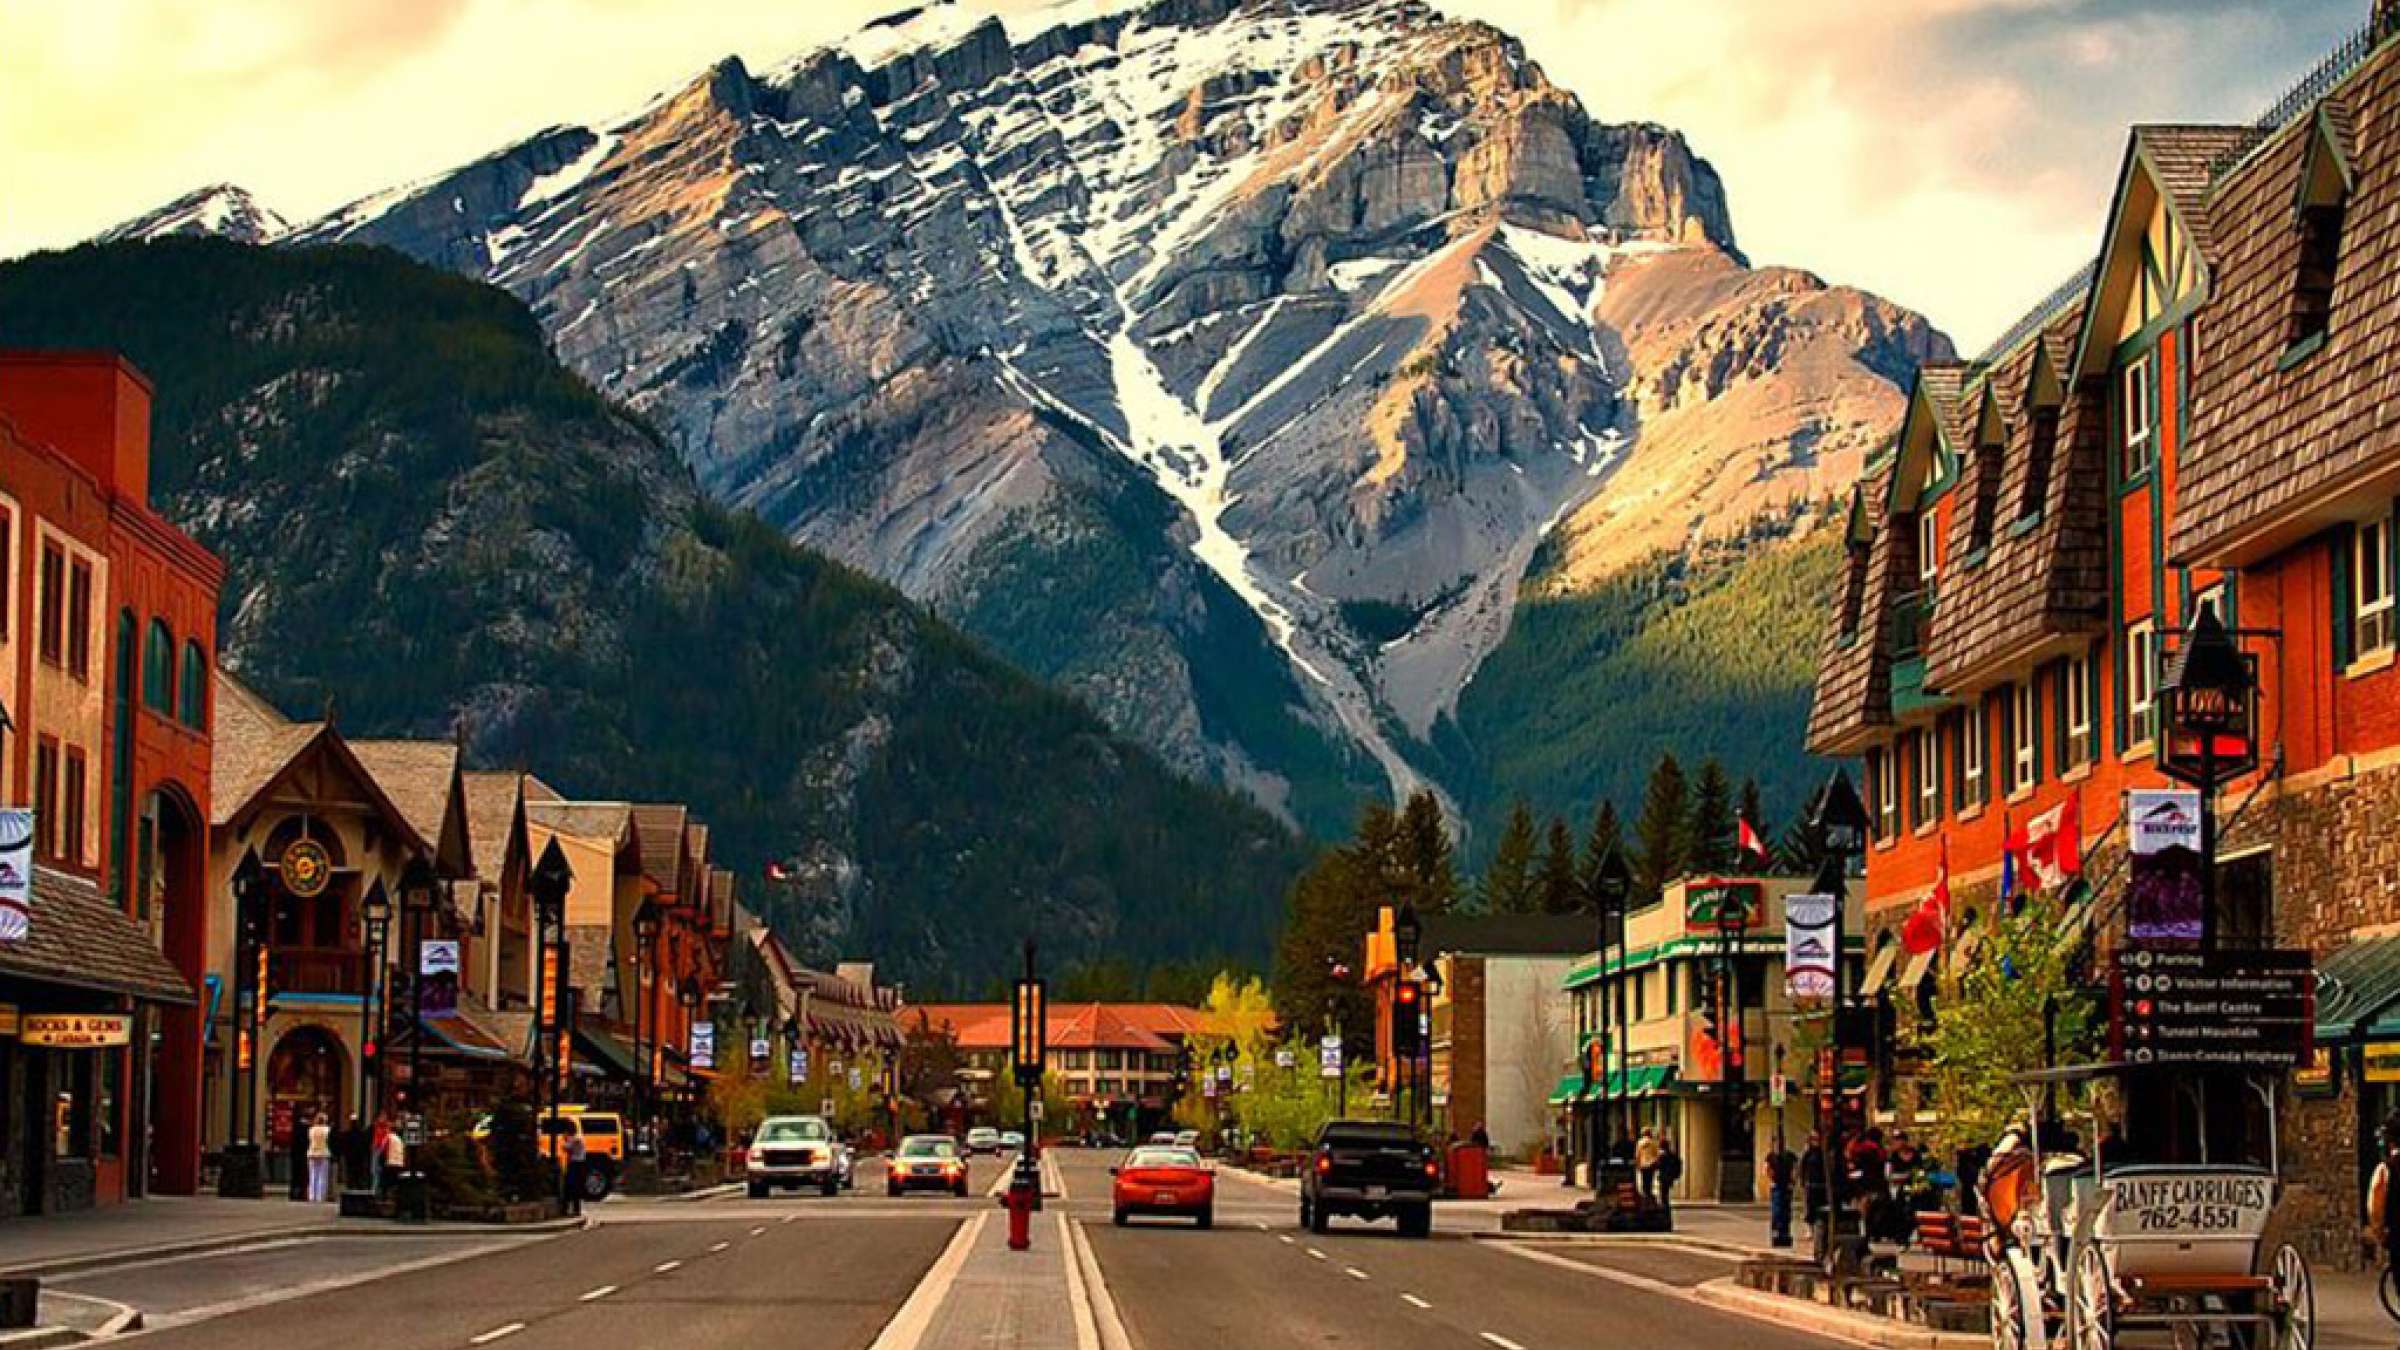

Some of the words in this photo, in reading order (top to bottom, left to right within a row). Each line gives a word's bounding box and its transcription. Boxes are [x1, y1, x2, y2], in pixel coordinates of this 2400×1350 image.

[2157, 953, 2204, 968] Parking
[2175, 978, 2217, 990] Visitor
[2221, 977, 2293, 990] Information
[2158, 1001, 2181, 1014] The
[2184, 1001, 2217, 1014] Banff
[27, 1019, 69, 1032] ROCKS
[89, 1019, 122, 1032] GEMS
[2158, 1026, 2200, 1039] Tunnel
[2202, 1026, 2259, 1039] Mountain
[2115, 1180, 2170, 1211] BANFF
[2172, 1179, 2265, 1210] CARRIAGES
[2139, 1205, 2238, 1231] 762-4551
